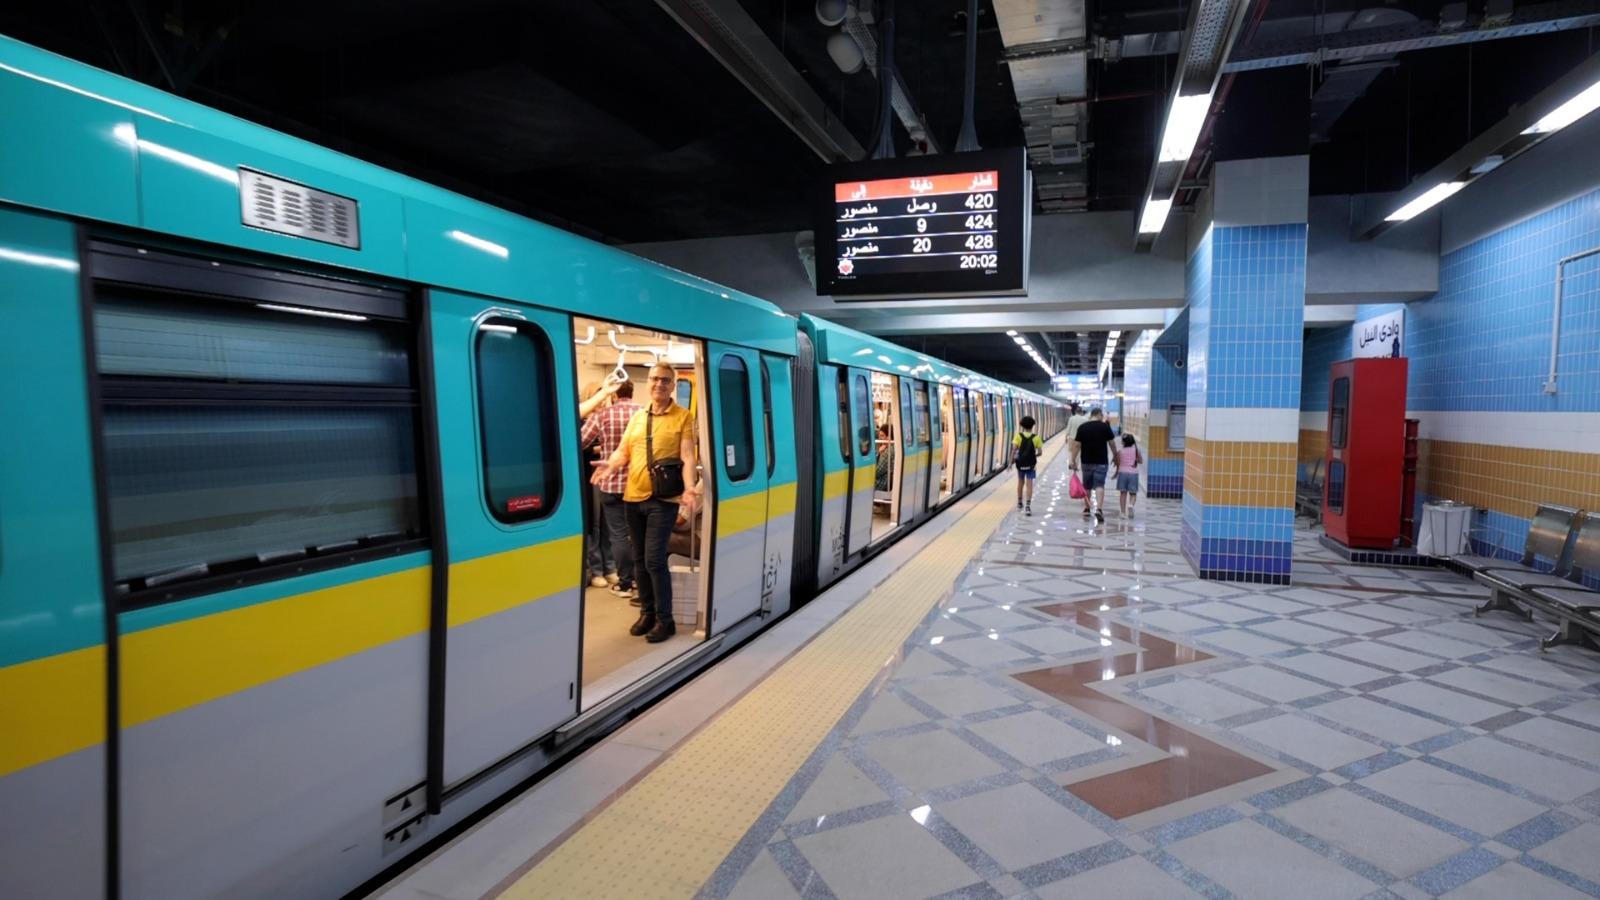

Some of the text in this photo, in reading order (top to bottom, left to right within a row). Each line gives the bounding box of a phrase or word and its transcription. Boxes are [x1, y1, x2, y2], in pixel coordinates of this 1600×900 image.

[840, 193, 994, 219] 420 وصل منصور
[841, 214, 994, 238] 424 9 منصور
[841, 235, 994, 258] 428 20 منصور
[960, 255, 998, 268] 20:02
